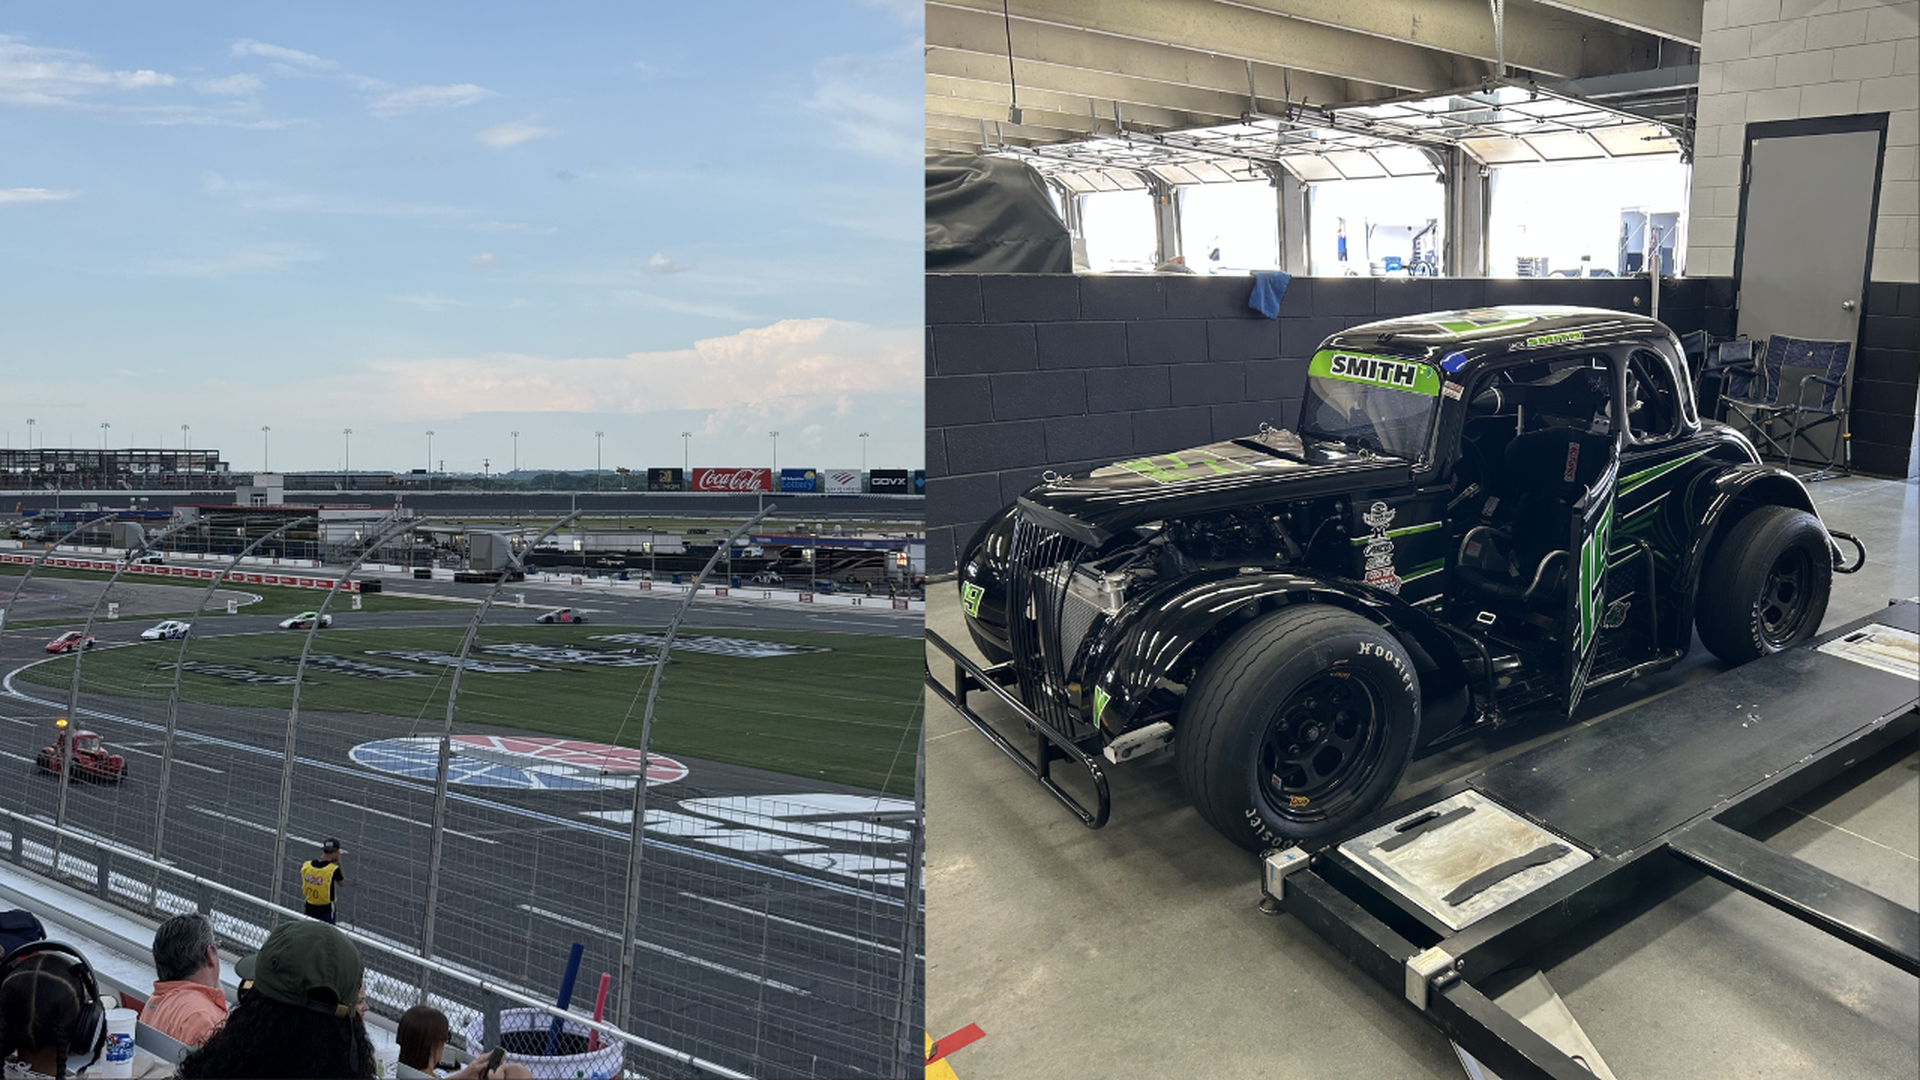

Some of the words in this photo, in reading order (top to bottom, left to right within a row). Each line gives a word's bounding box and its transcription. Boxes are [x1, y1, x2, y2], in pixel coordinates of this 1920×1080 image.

[1527, 331, 1583, 347] SMITH
[1330, 354, 1417, 388] SMITH
[698, 468, 766, 490] Coca-Cola
[781, 480, 814, 490] Lottery
[872, 477, 906, 486] GOVX
